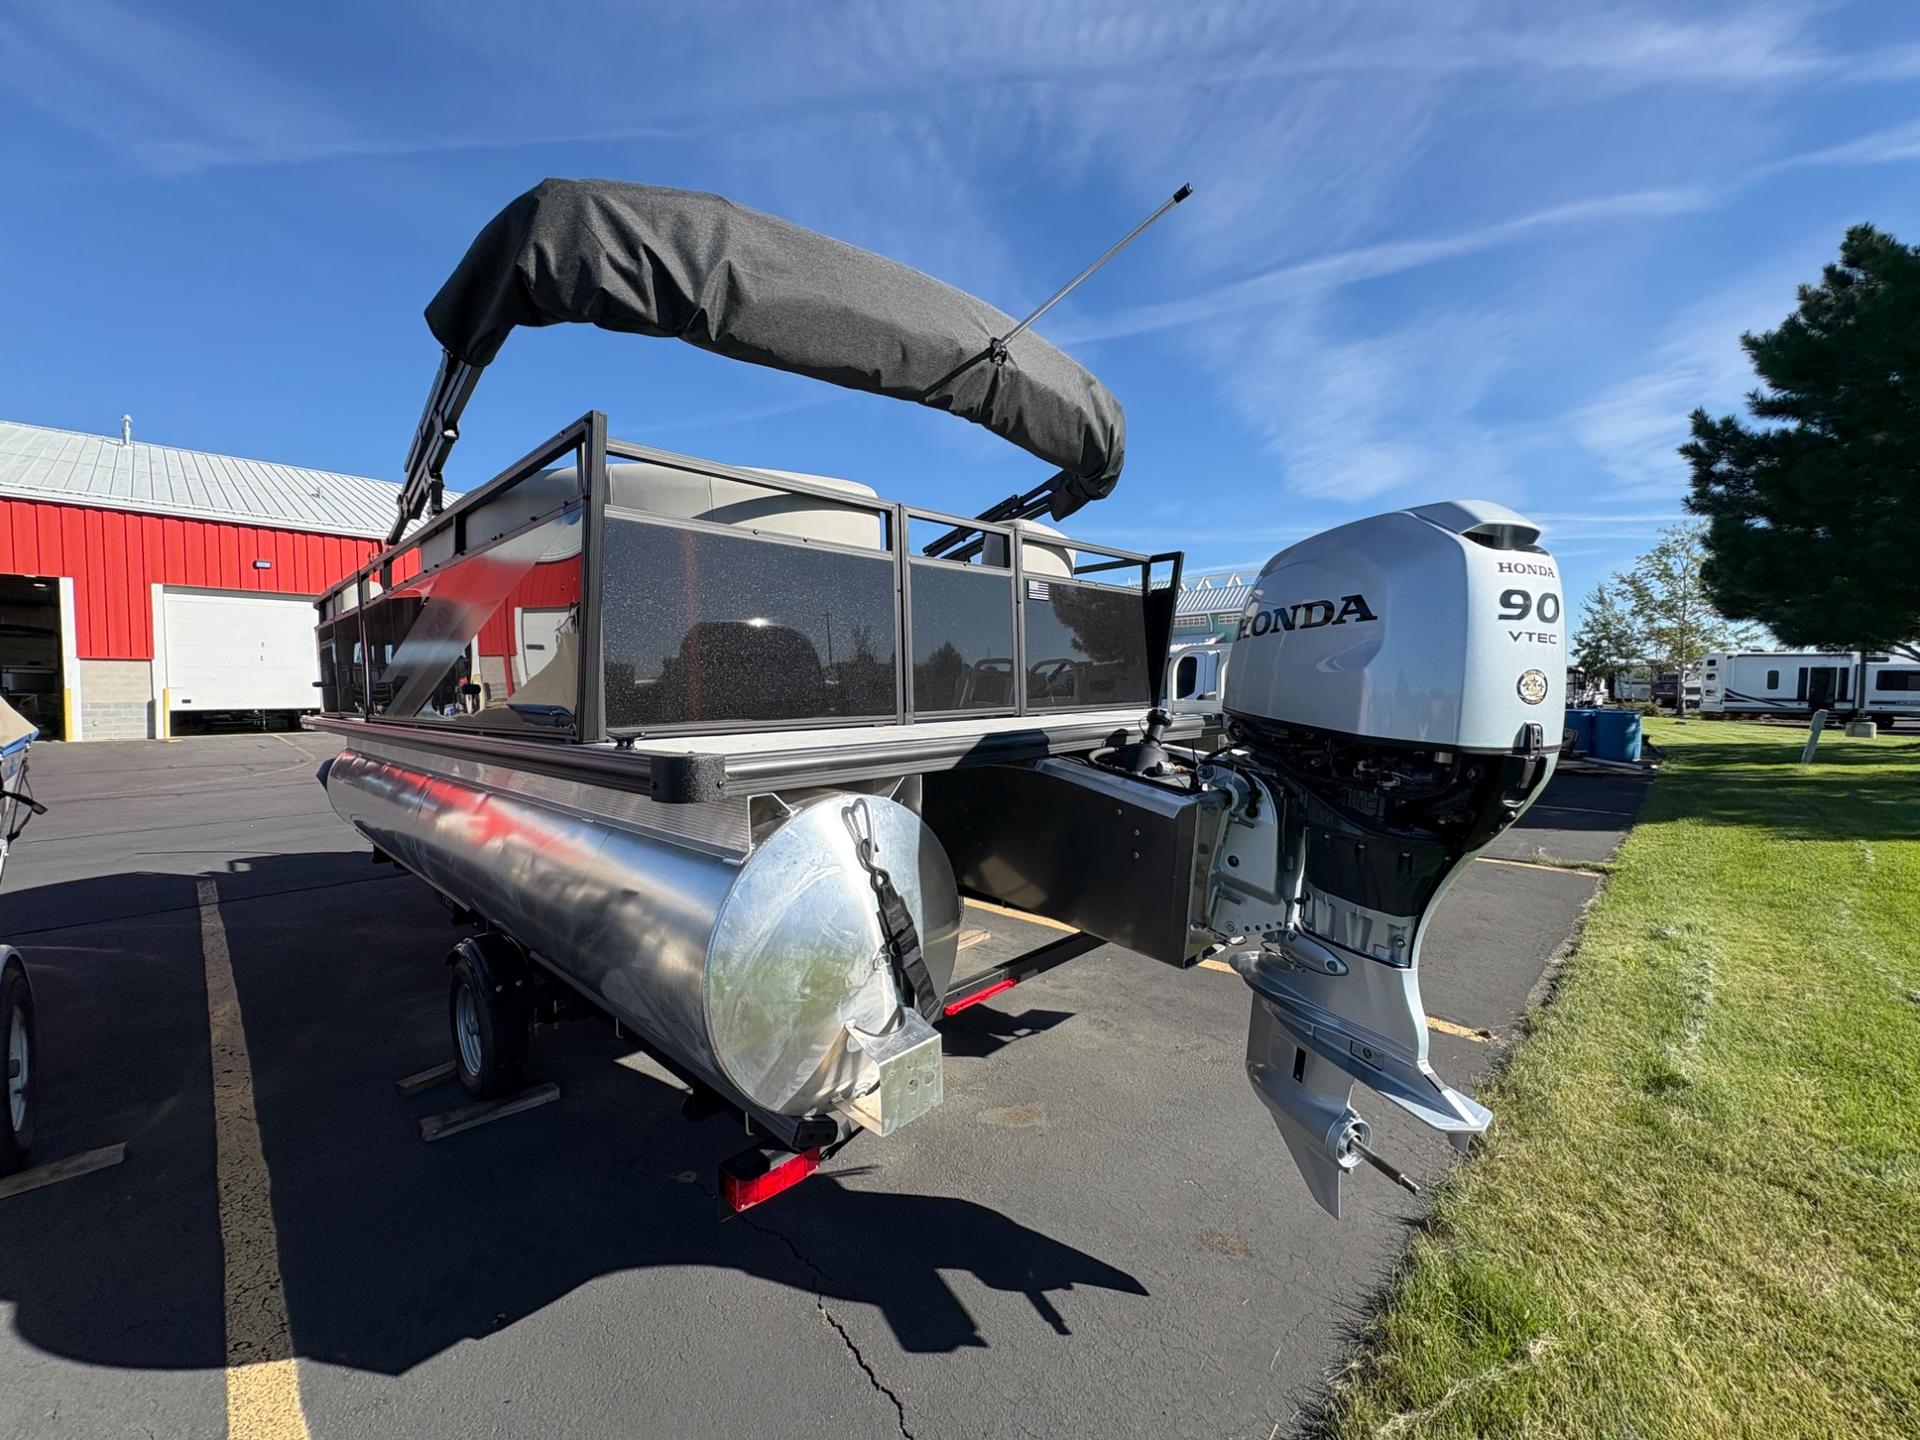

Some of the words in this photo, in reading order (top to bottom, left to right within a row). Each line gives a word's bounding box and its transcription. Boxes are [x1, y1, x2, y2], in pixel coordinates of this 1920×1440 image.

[1497, 562, 1555, 578] HONDA
[1236, 594, 1378, 641] HONDA
[1498, 588, 1560, 624] 90
[1508, 630, 1557, 645] VTEC
